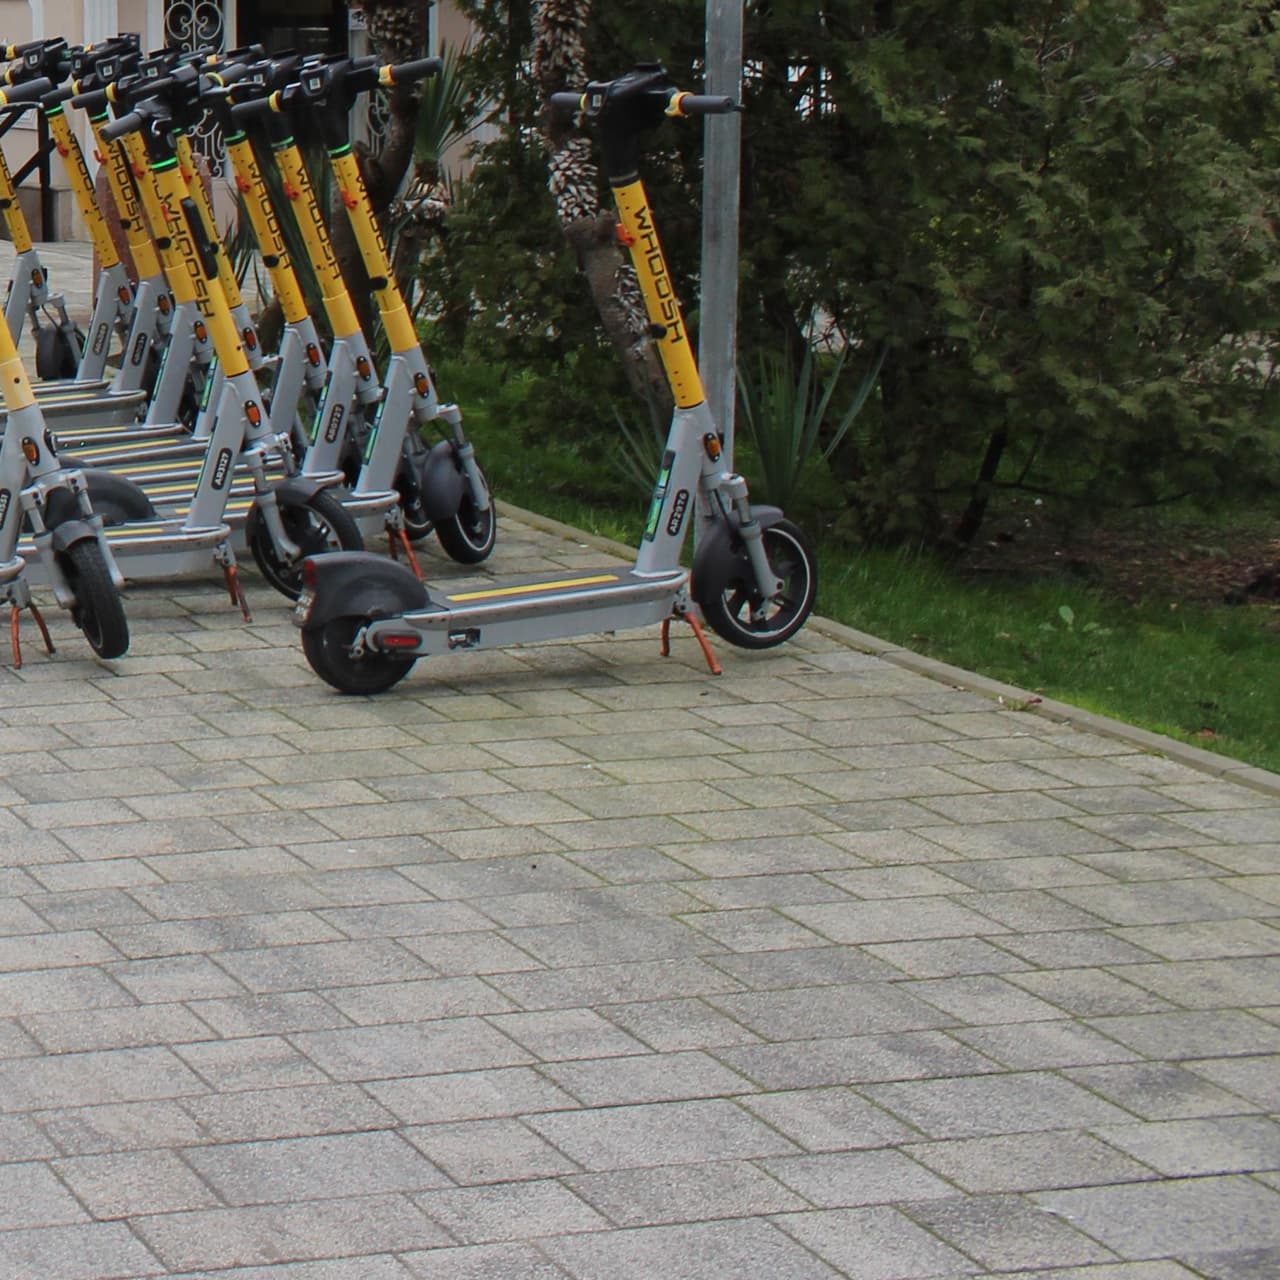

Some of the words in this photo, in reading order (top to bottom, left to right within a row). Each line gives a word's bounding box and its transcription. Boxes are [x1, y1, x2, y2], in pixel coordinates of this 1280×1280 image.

[107, 142, 144, 233] WHOOSH
[248, 161, 291, 270] WHOOSH
[296, 167, 340, 280] WHOOSH
[162, 191, 215, 318] WHOOSH
[633, 205, 684, 345] WHOOSH
